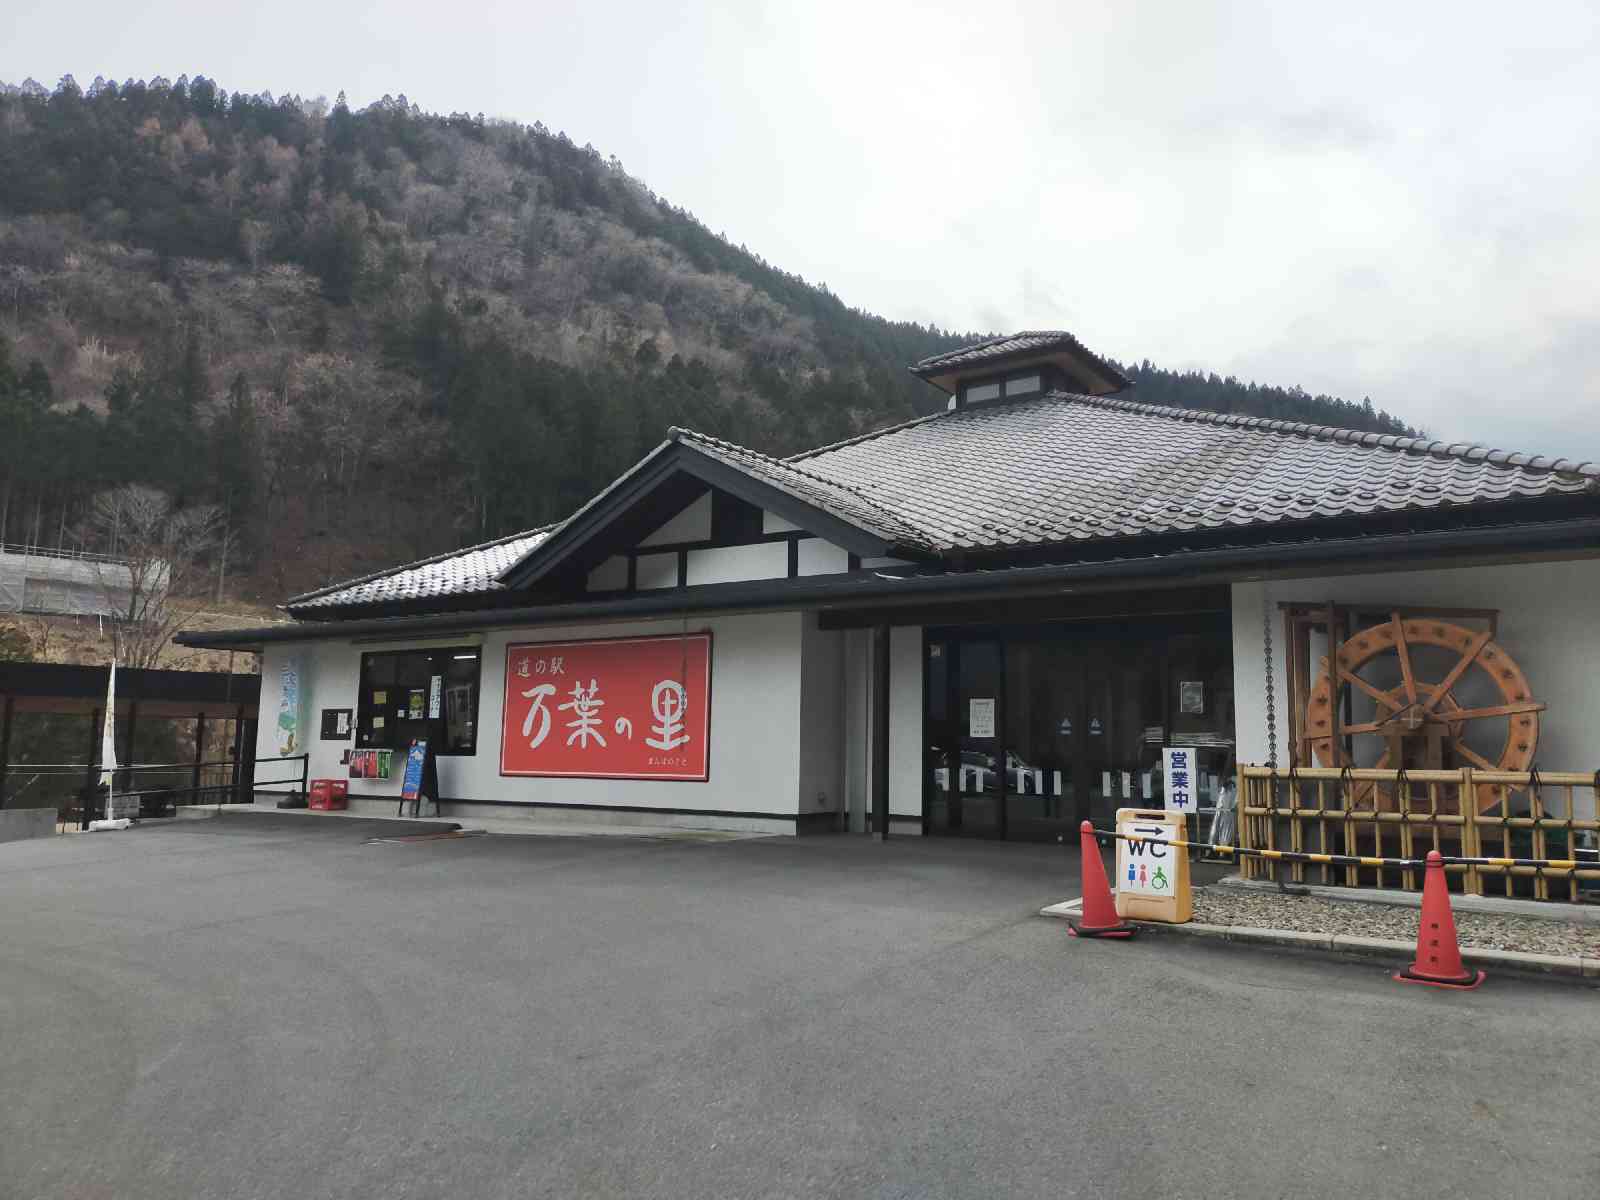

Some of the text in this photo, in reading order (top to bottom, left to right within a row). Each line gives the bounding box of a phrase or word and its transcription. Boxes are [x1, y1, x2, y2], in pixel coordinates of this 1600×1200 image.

[517, 656, 565, 678] 道の駅
[521, 679, 690, 750] 万葉の里
[1171, 752, 1189, 808] 営業中
[1128, 839, 1167, 858] WC
